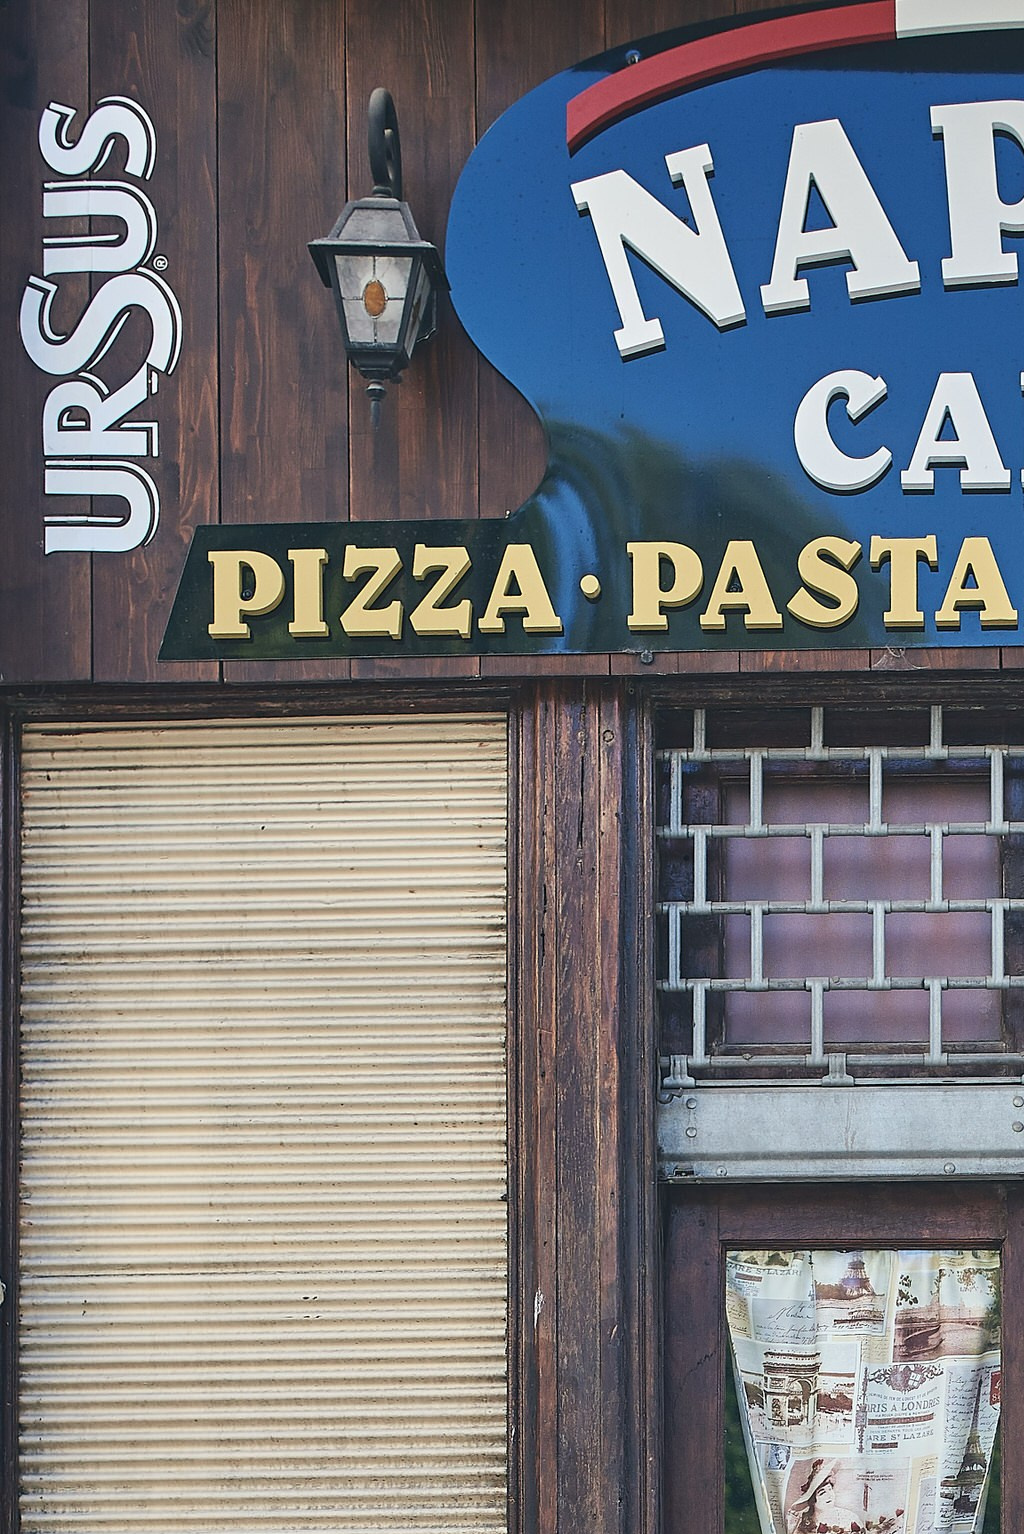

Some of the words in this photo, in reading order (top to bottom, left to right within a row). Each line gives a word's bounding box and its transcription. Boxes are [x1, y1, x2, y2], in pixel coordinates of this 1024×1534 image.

[19, 95, 183, 556] URSUS
[206, 542, 563, 641] PIZZA
[626, 534, 1019, 633] PASTA
